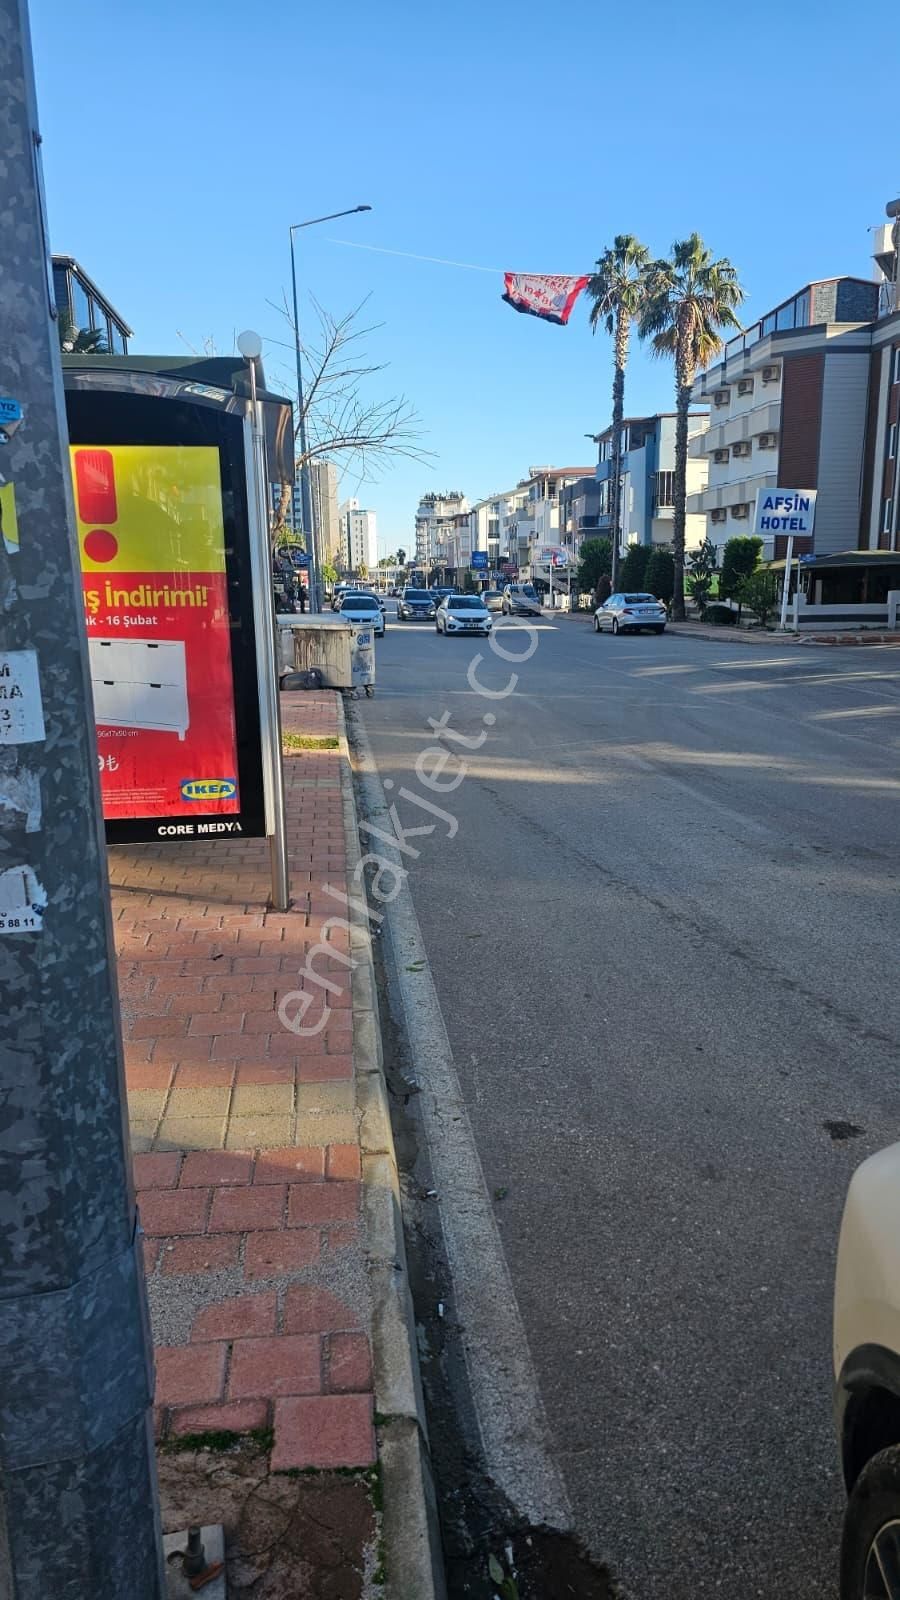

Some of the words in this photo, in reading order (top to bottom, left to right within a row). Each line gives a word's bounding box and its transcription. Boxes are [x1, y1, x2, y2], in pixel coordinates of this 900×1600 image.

[763, 494, 809, 512] AFŞİN
[761, 517, 806, 531] HOTEL
[105, 580, 208, 607] İndirimi!
[106, 616, 120, 625] 16
[123, 615, 158, 628] Şubat
[187, 785, 231, 794] IKEA
[158, 825, 194, 836] CORE
[197, 822, 242, 833] MEDYA
[8, 919, 20, 928] 88
[24, 918, 35, 926] 11
